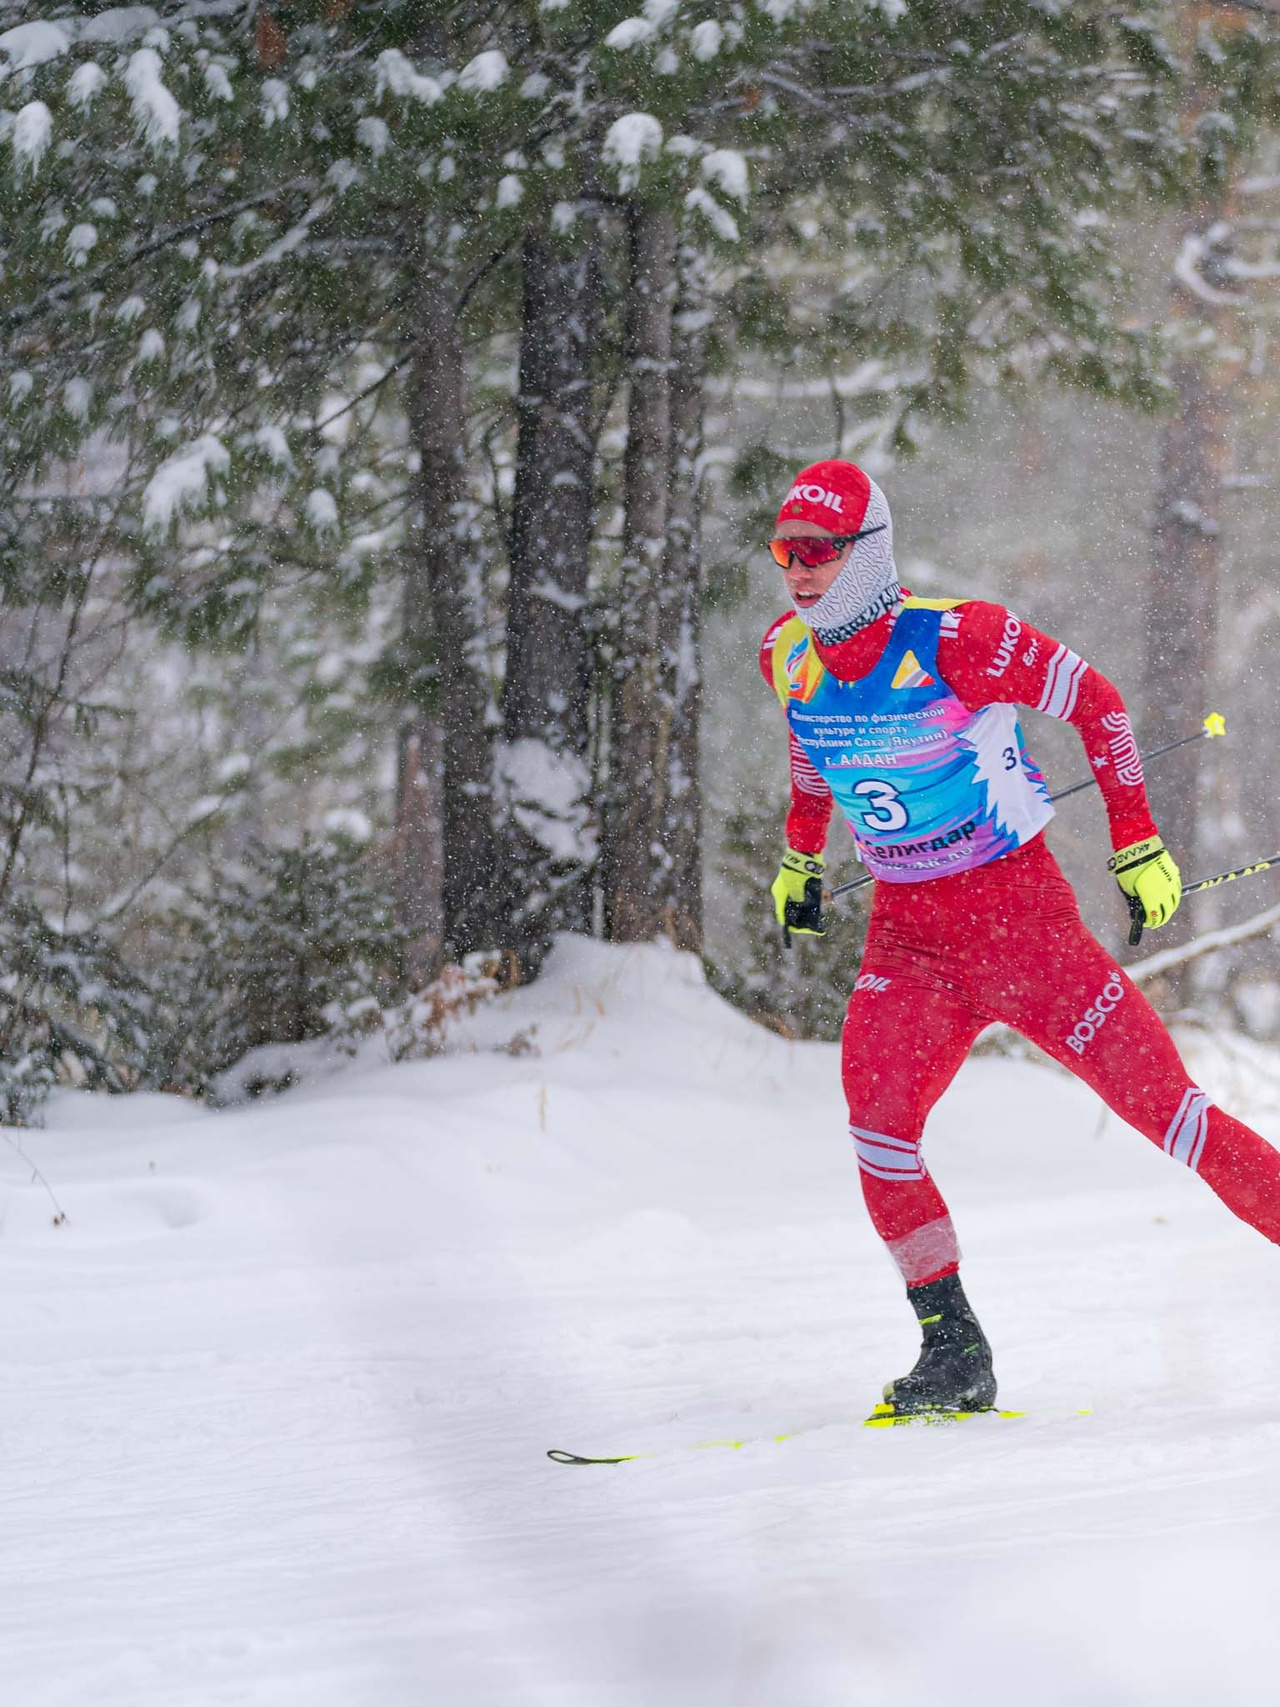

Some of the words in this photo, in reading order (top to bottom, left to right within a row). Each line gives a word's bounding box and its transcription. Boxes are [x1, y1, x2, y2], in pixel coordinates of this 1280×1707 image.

[783, 484, 844, 514] KOIL
[854, 714, 869, 723] по
[871, 706, 946, 724] физической
[854, 737, 885, 748] Саха
[887, 729, 949, 749] (Якутия)
[858, 726, 867, 735] и
[868, 725, 909, 736] спорту
[840, 753, 898, 768] АЛДАН
[1002, 746, 1017, 771] 3
[852, 778, 910, 832] 3
[1064, 982, 1125, 1056] BOSCO
